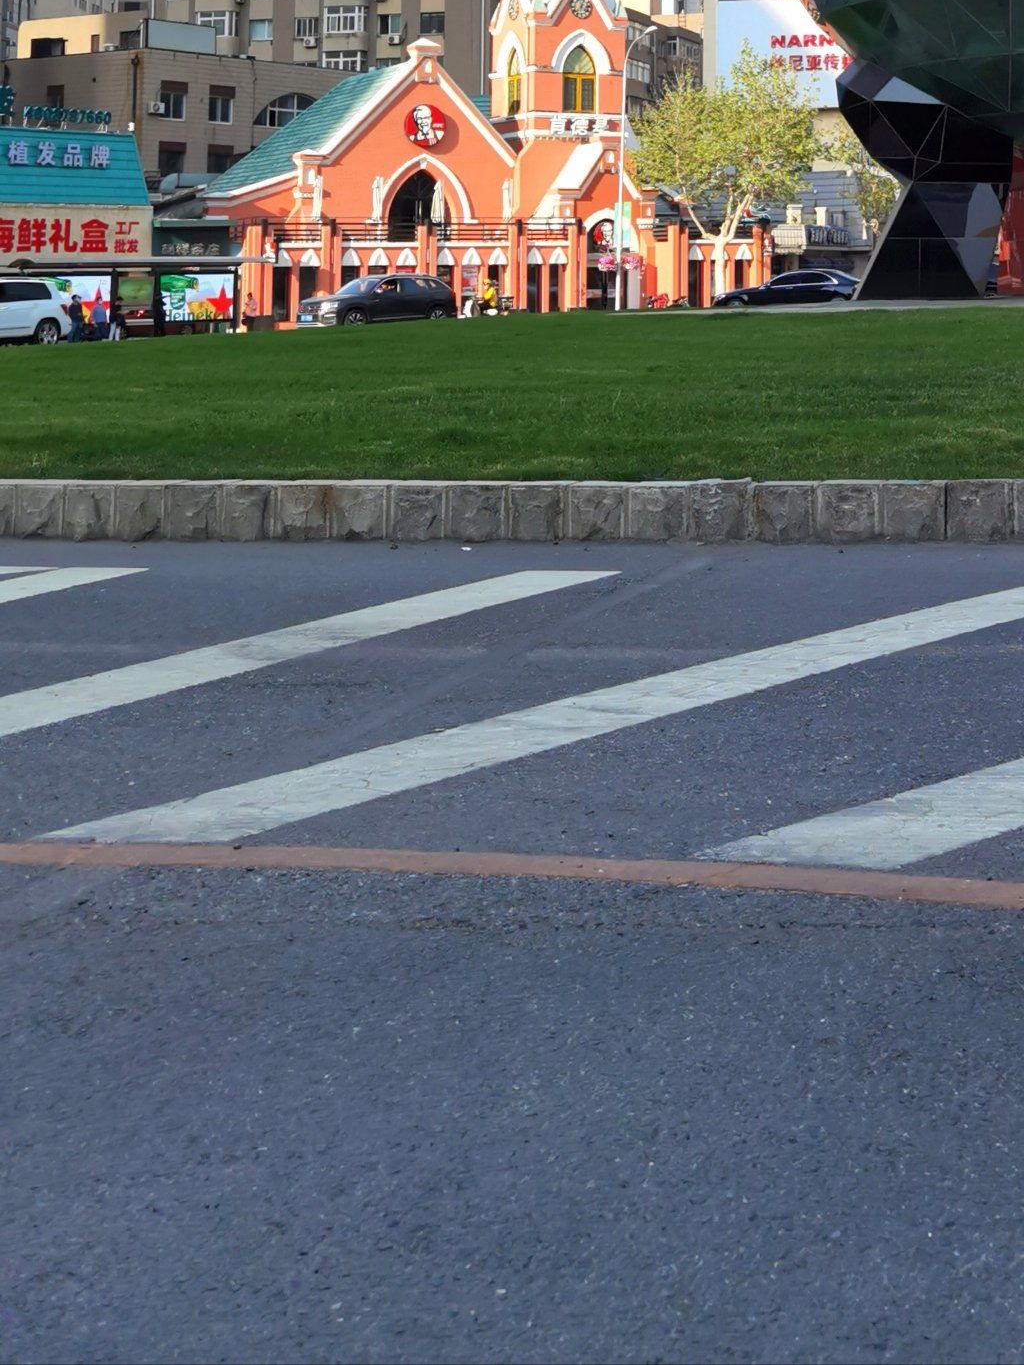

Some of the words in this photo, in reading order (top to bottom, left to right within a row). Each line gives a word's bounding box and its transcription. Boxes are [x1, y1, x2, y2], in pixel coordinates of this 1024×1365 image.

[8, 140, 110, 168] 植发品牌
[0, 218, 109, 253] 海鲜礼盒
[115, 221, 139, 235] 工厂
[114, 239, 139, 253] 批发
